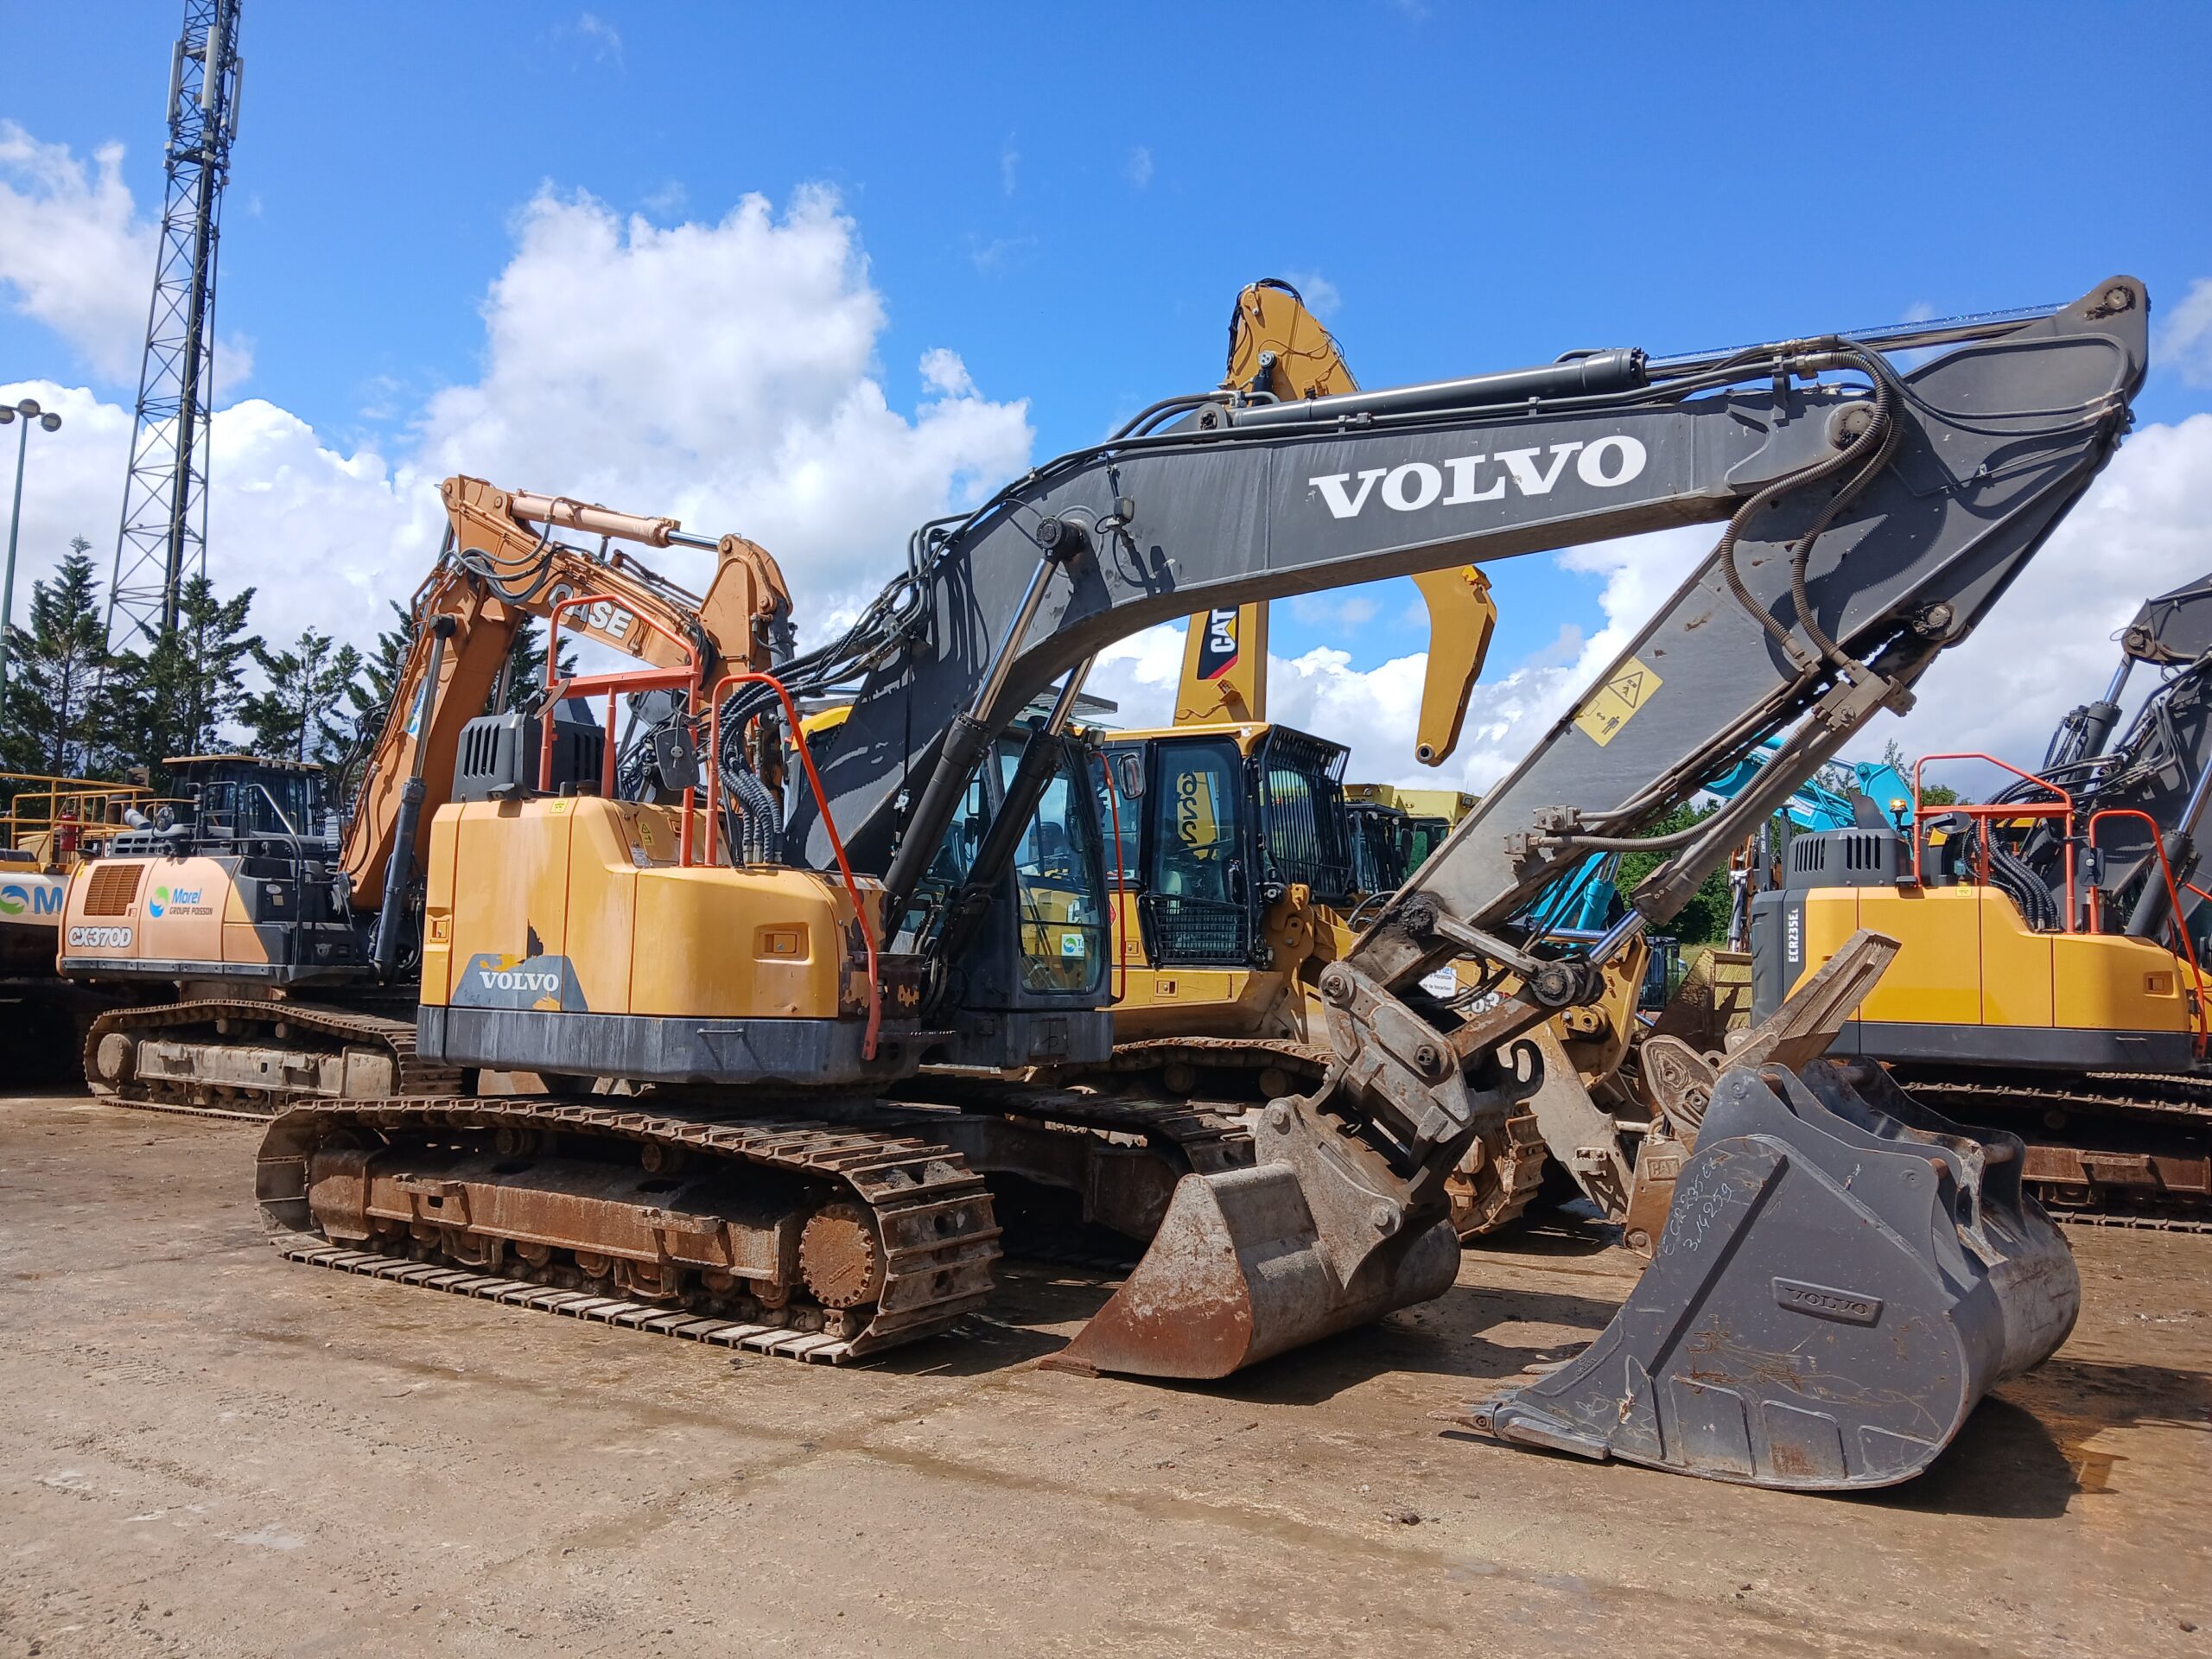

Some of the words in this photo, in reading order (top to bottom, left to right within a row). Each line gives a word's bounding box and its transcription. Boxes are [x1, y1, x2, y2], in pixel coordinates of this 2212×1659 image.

[1309, 435, 1647, 519] VOLVO
[548, 582, 633, 639] CASE
[1211, 608, 1236, 652] CAT
[34, 887, 63, 915] M
[172, 887, 202, 904] Morel
[169, 906, 191, 915] GROUPE
[192, 906, 213, 916] POISSON
[68, 926, 132, 947] CX370D
[1788, 908, 1799, 963] ECR235EL
[479, 971, 559, 992] VOLVO
[1783, 1287, 1868, 1316] VOLVO
